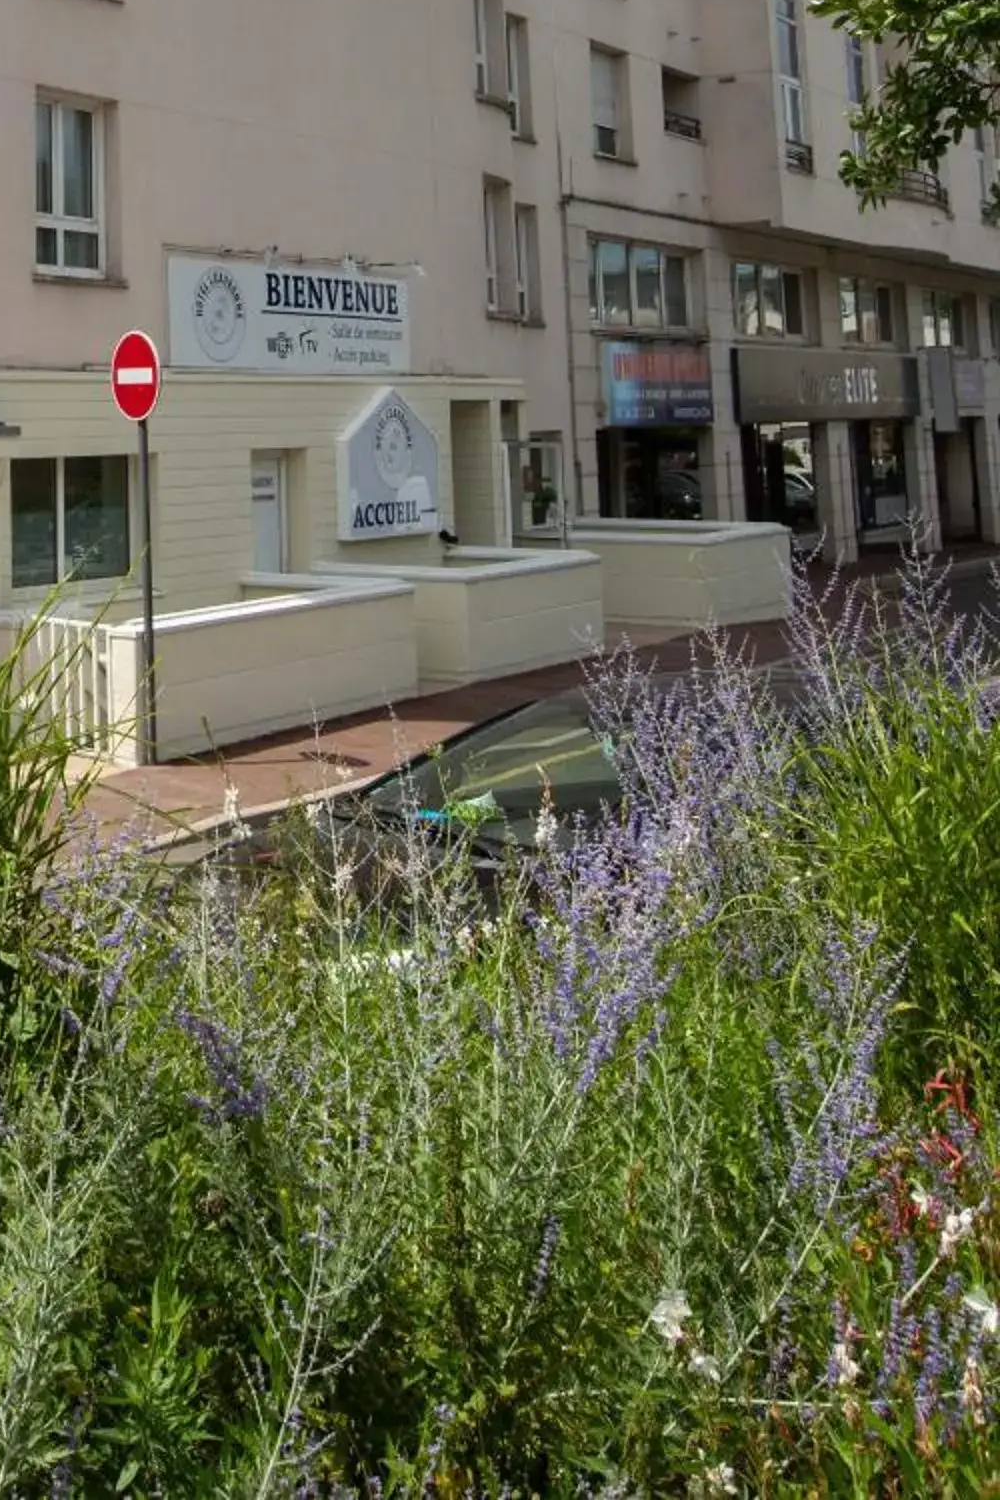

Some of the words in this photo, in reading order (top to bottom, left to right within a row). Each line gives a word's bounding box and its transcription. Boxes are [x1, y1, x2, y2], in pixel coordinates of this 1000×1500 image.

[265, 273, 399, 315] BIENVENUE
[305, 339, 318, 354] TV
[352, 499, 421, 528] ACCUEIL
